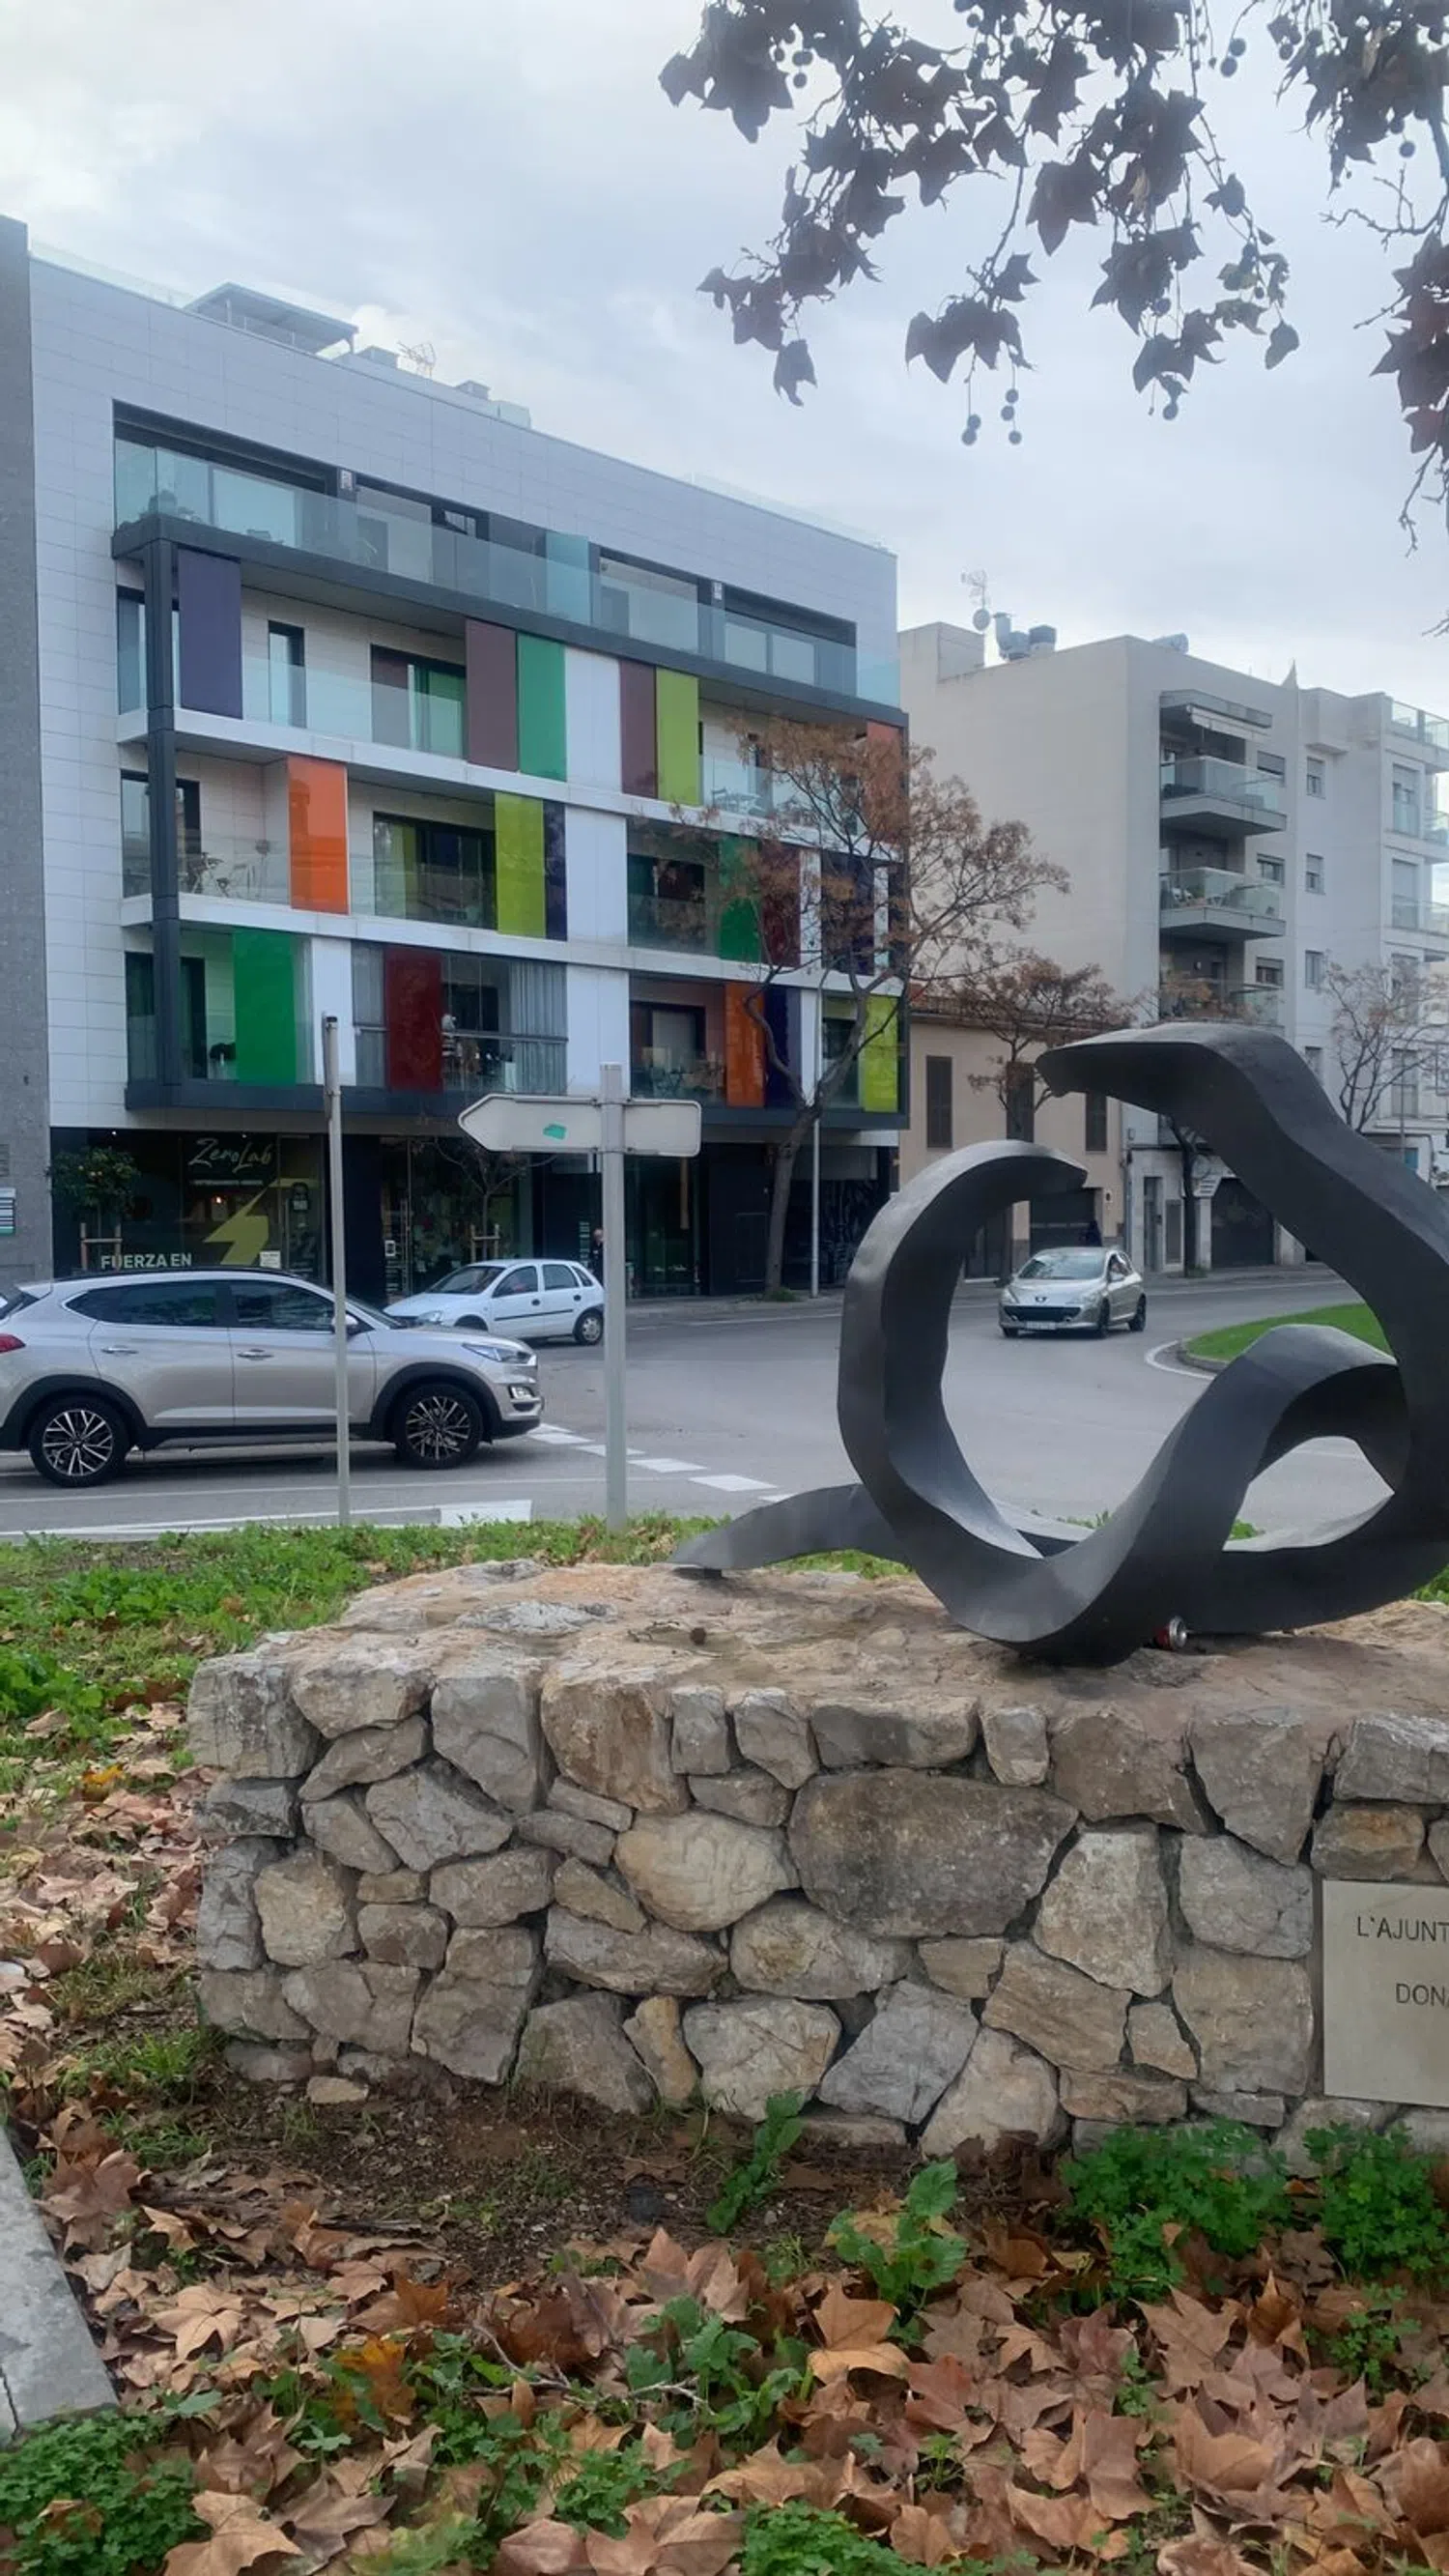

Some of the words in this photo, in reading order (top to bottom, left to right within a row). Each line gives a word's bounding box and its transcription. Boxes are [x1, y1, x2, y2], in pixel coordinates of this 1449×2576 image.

[100, 1253, 168, 1270] FUERZA
[170, 1252, 192, 1267] EN
[1396, 1983, 1449, 2008] DON
